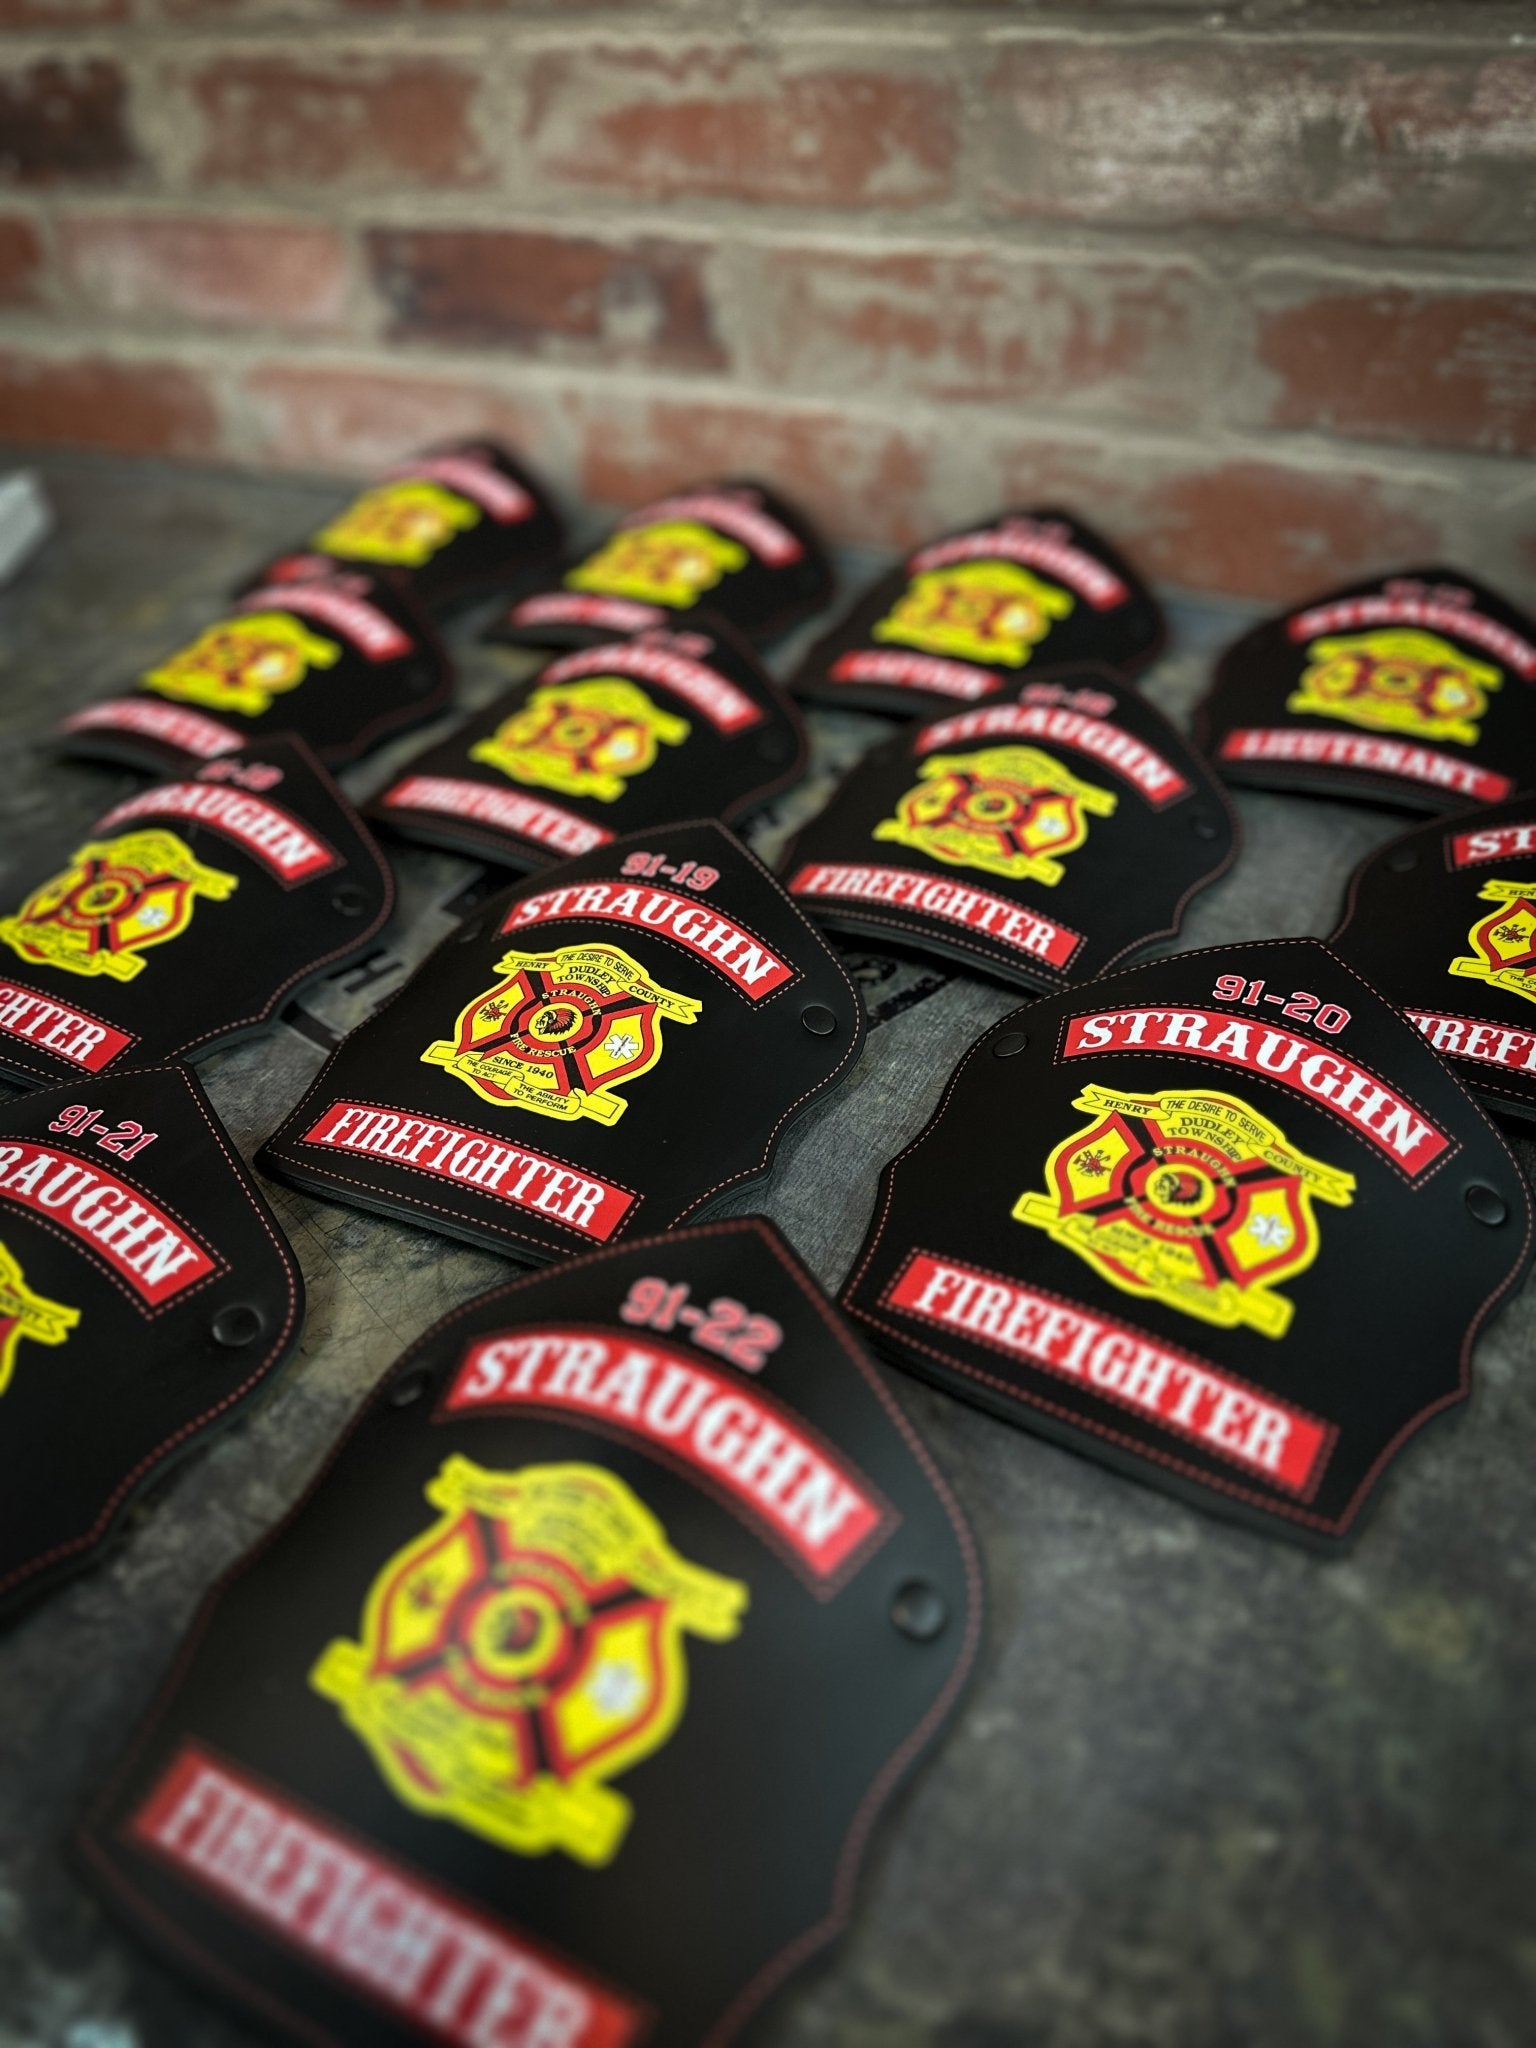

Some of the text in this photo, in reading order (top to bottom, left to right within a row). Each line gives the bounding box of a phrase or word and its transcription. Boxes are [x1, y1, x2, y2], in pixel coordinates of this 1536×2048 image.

[620, 851, 720, 891] 91-19
[804, 866, 1057, 957] FIREFIGHTER
[514, 884, 781, 987] STRAUGHN
[514, 961, 550, 970] HENRY
[560, 952, 635, 981] THE DESIRE TO SERVE
[568, 965, 617, 985] DUDLEY
[557, 973, 611, 998] TOWNSHIP
[628, 985, 676, 1009] COUNTY
[541, 988, 603, 1017] STRAUGHN
[1213, 975, 1351, 1034] 91-20
[510, 1031, 577, 1058] FIRE RESCUE
[466, 1059, 513, 1077] THE COURAGE
[472, 1068, 481, 1076] TO
[492, 1056, 554, 1079] SINCE 1940
[518, 1083, 570, 1104] THE ABILITY
[1076, 1012, 1435, 1157] STRAUGHN
[513, 1088, 569, 1111] TO PERFORM
[1103, 1099, 1154, 1116] HENRY
[48, 1104, 159, 1162] 91-21
[1166, 1099, 1267, 1142] THE DESIRE TO SERVE
[1180, 1117, 1247, 1146] DUDLEY
[1167, 1126, 1243, 1162] TOWNSHIP
[320, 1107, 606, 1229] FIREFIGHTER
[1263, 1150, 1323, 1184] COUNTY
[619, 1276, 783, 1372] 91-22
[913, 1266, 1292, 1472] FIREFIGHTER
[464, 1333, 859, 1548] STRAUGHN
